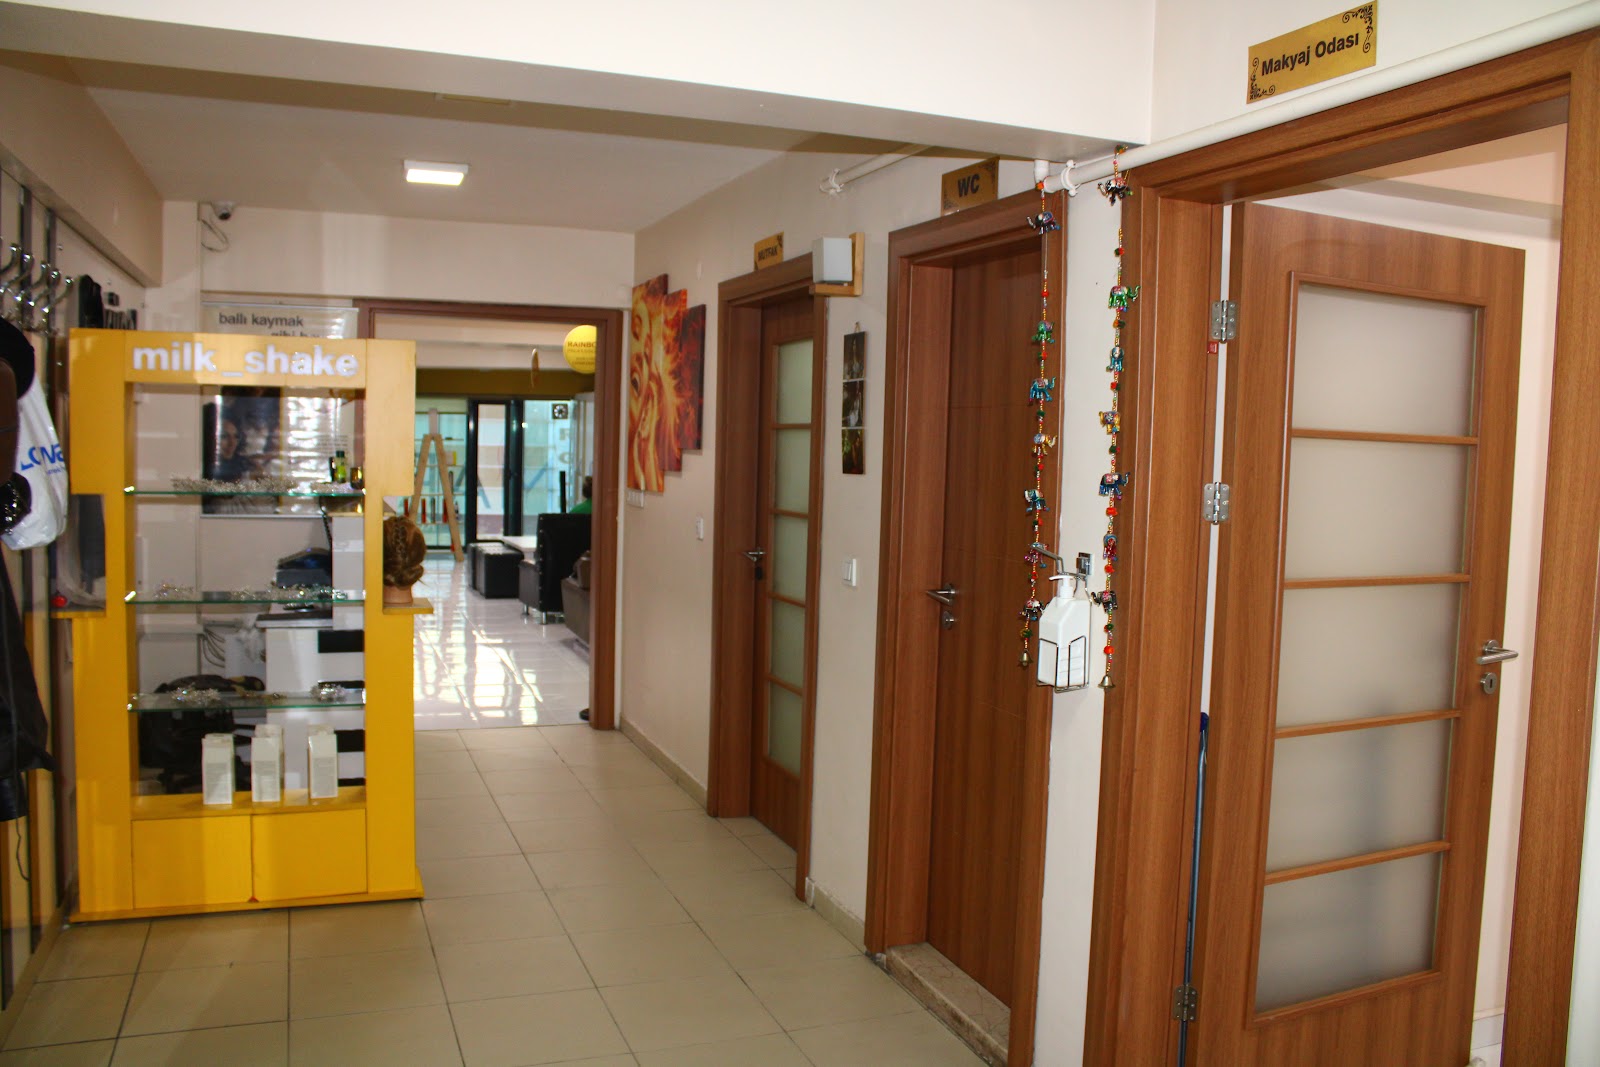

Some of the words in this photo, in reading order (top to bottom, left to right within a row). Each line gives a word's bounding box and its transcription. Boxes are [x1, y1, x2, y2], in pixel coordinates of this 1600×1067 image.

[1261, 45, 1310, 76] Makyaj
[1315, 33, 1359, 58] Odası
[957, 174, 980, 198] WC
[252, 314, 304, 328] kaymak
